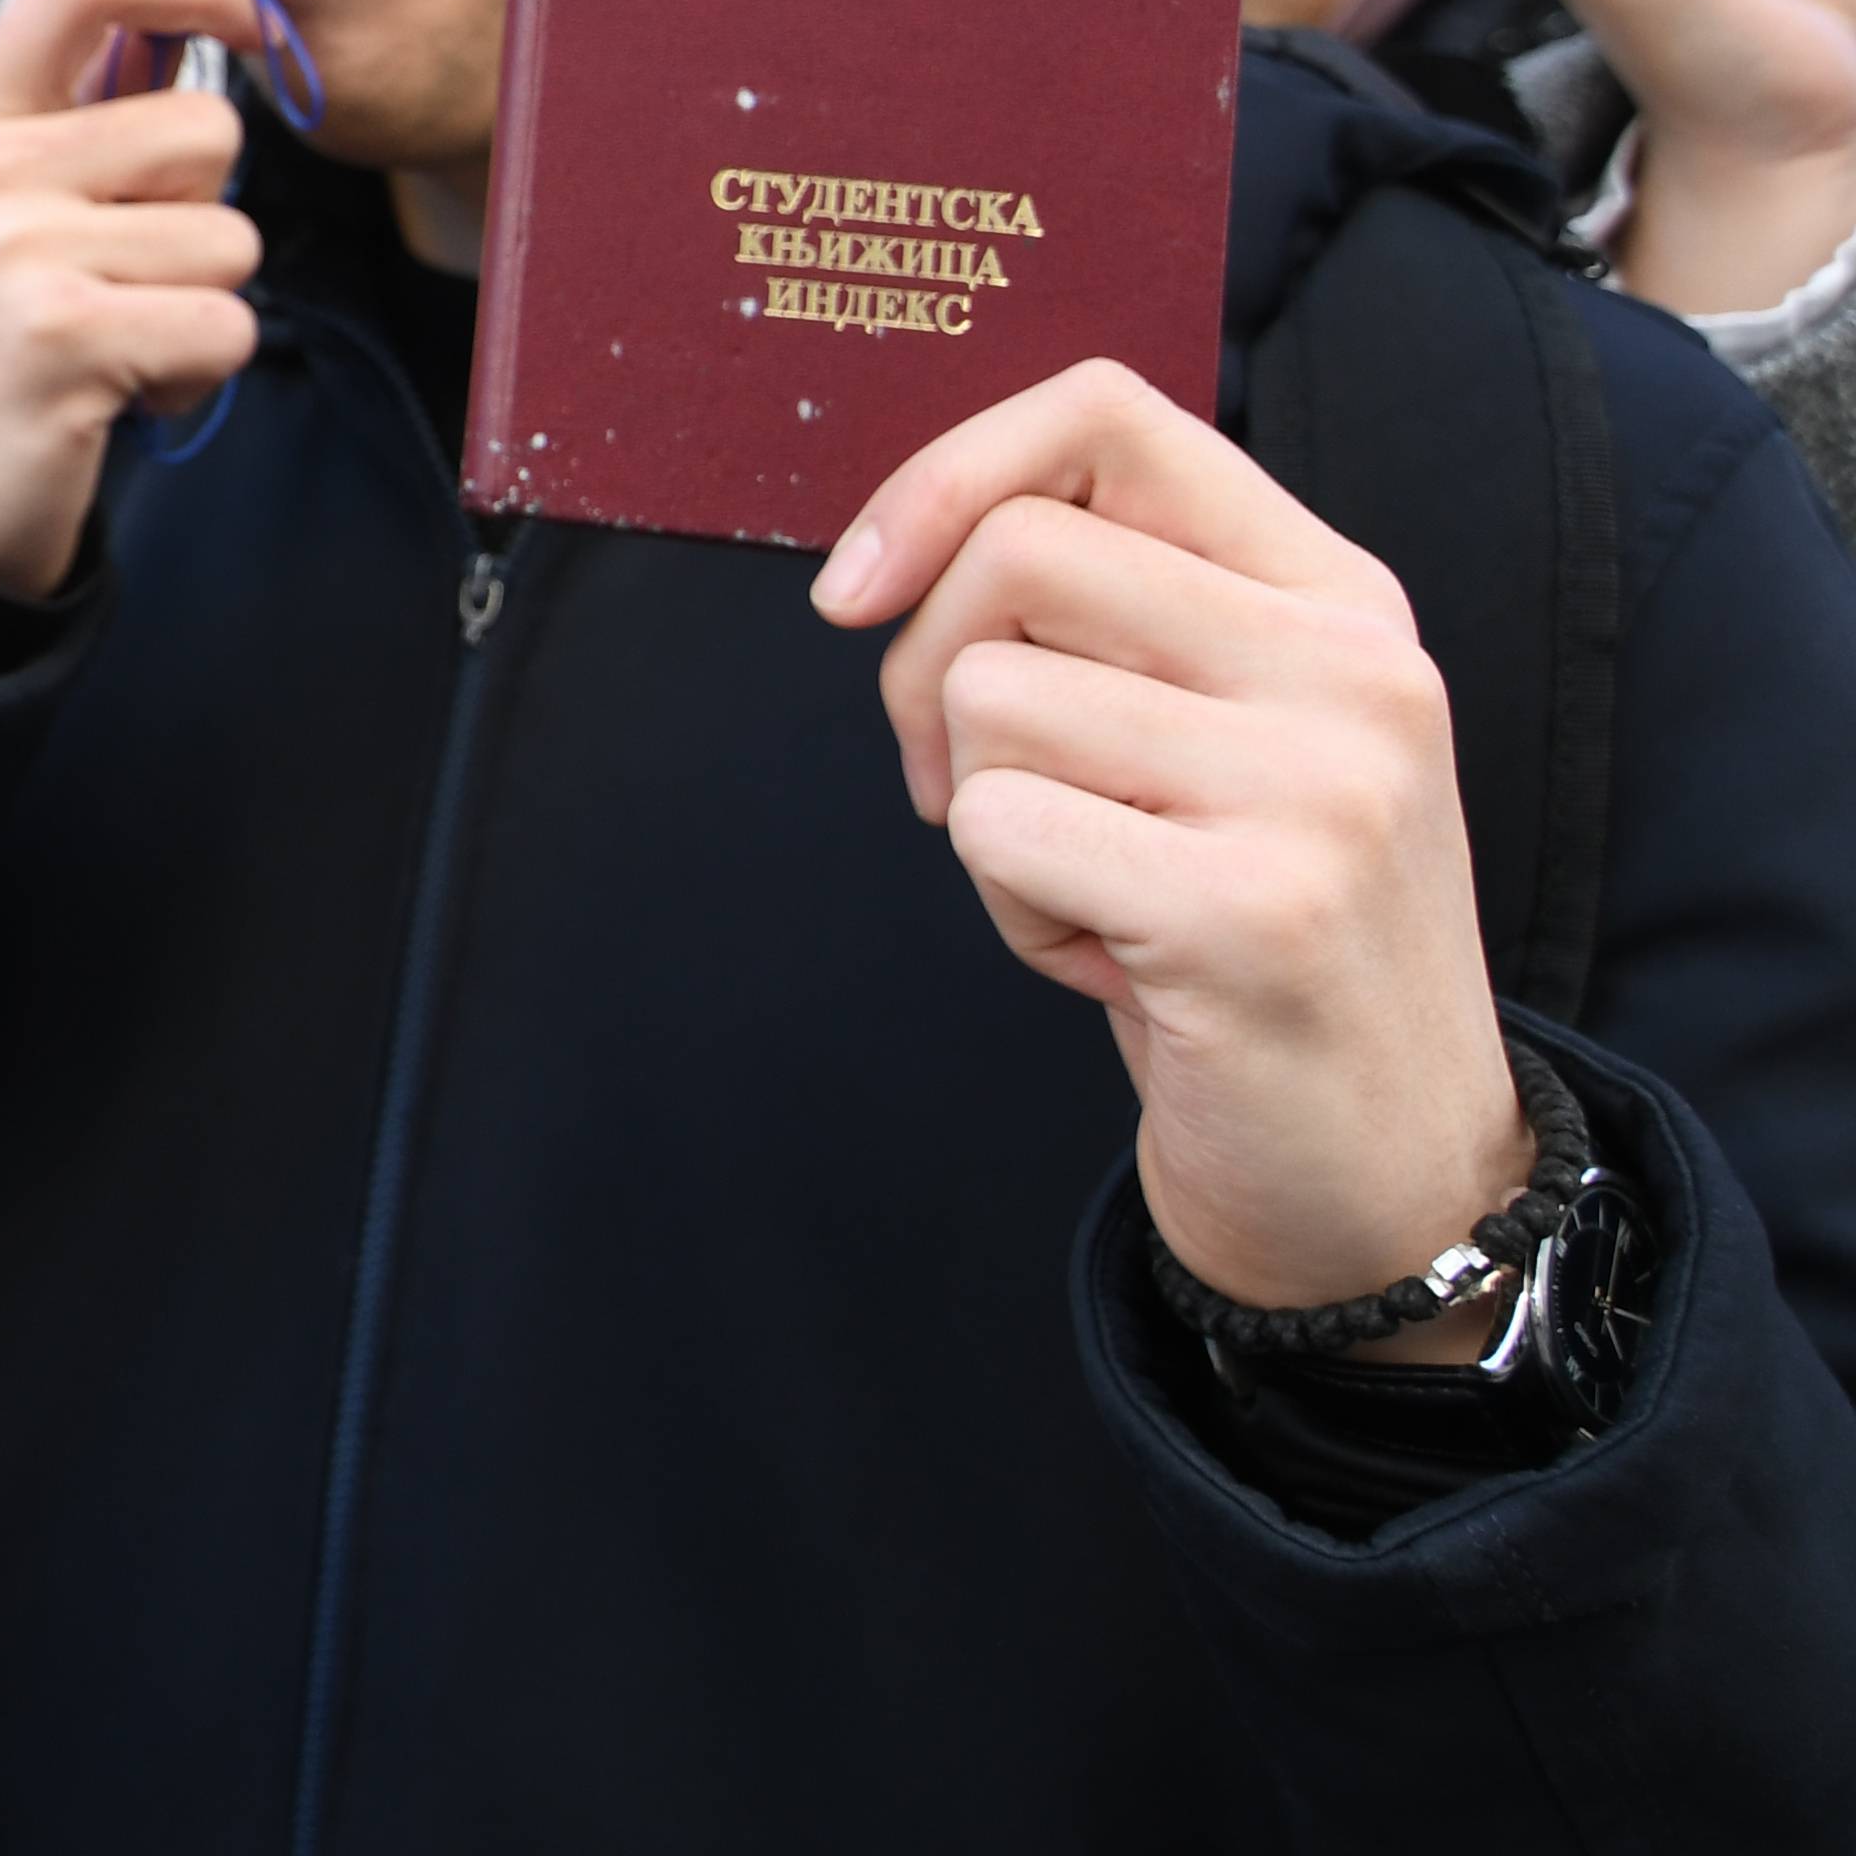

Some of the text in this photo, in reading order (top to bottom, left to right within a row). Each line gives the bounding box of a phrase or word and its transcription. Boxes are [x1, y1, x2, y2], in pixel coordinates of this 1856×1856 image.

[709, 166, 1046, 238] СТУДЕНТСКА
[734, 220, 1012, 292] КЊИЖИЦА
[763, 275, 974, 336] ИНДЕКС
